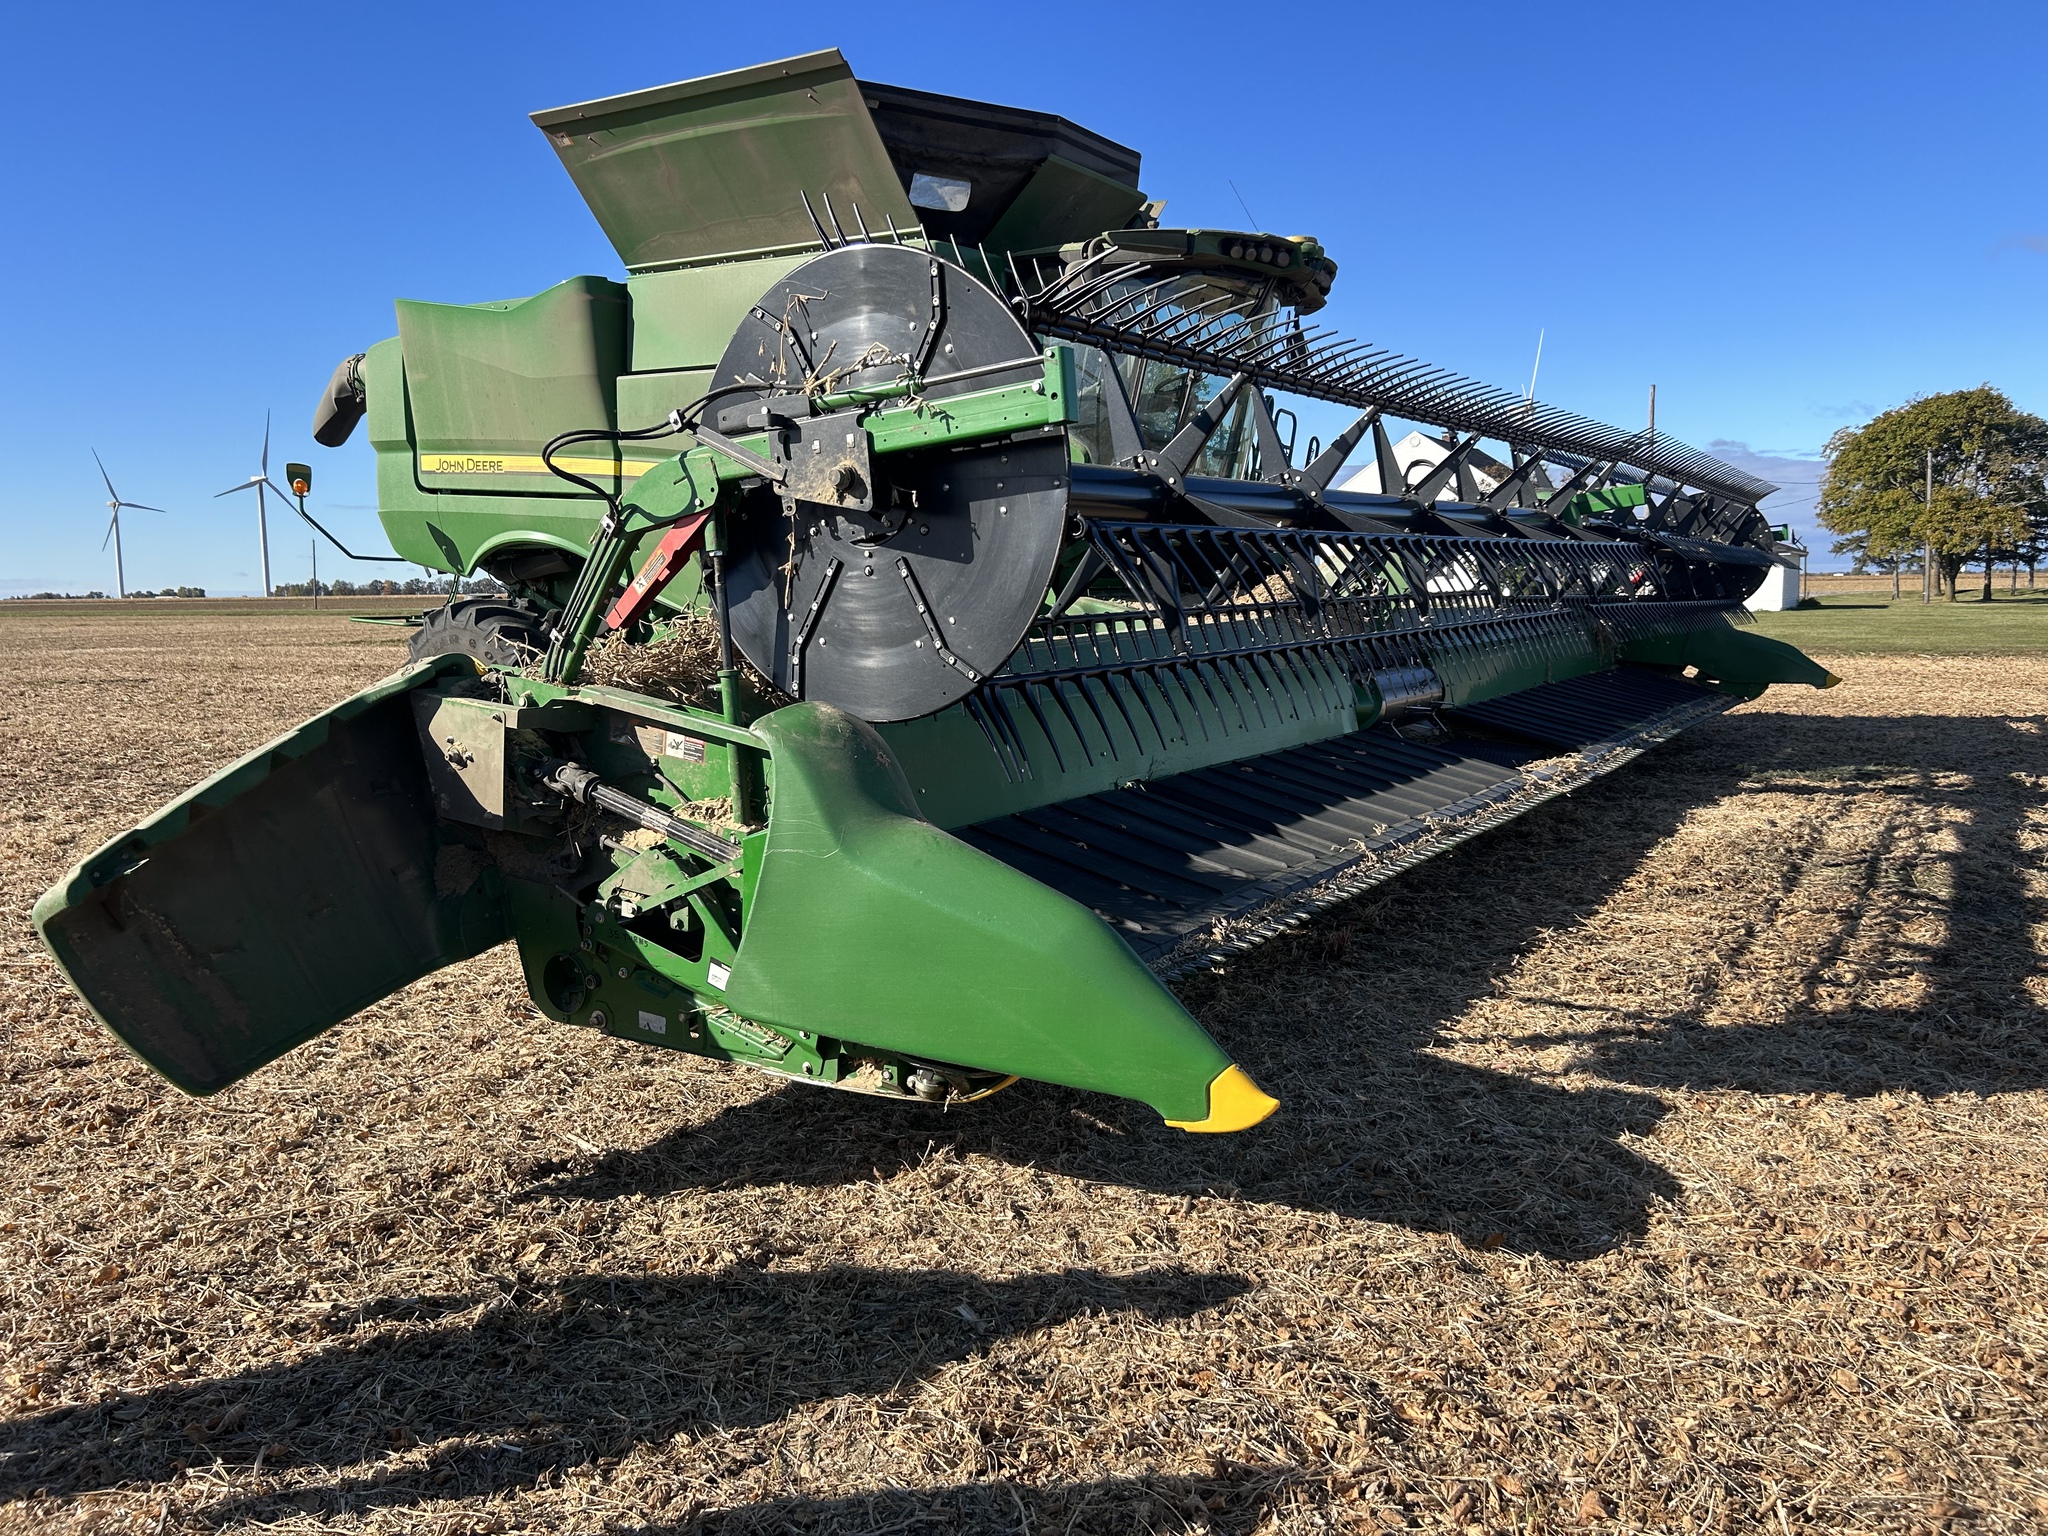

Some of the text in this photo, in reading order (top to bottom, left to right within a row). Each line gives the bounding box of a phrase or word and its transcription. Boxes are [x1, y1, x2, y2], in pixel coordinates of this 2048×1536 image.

[436, 458, 503, 471] JOHN DEERE
[609, 928, 649, 948] 35 TURNS
